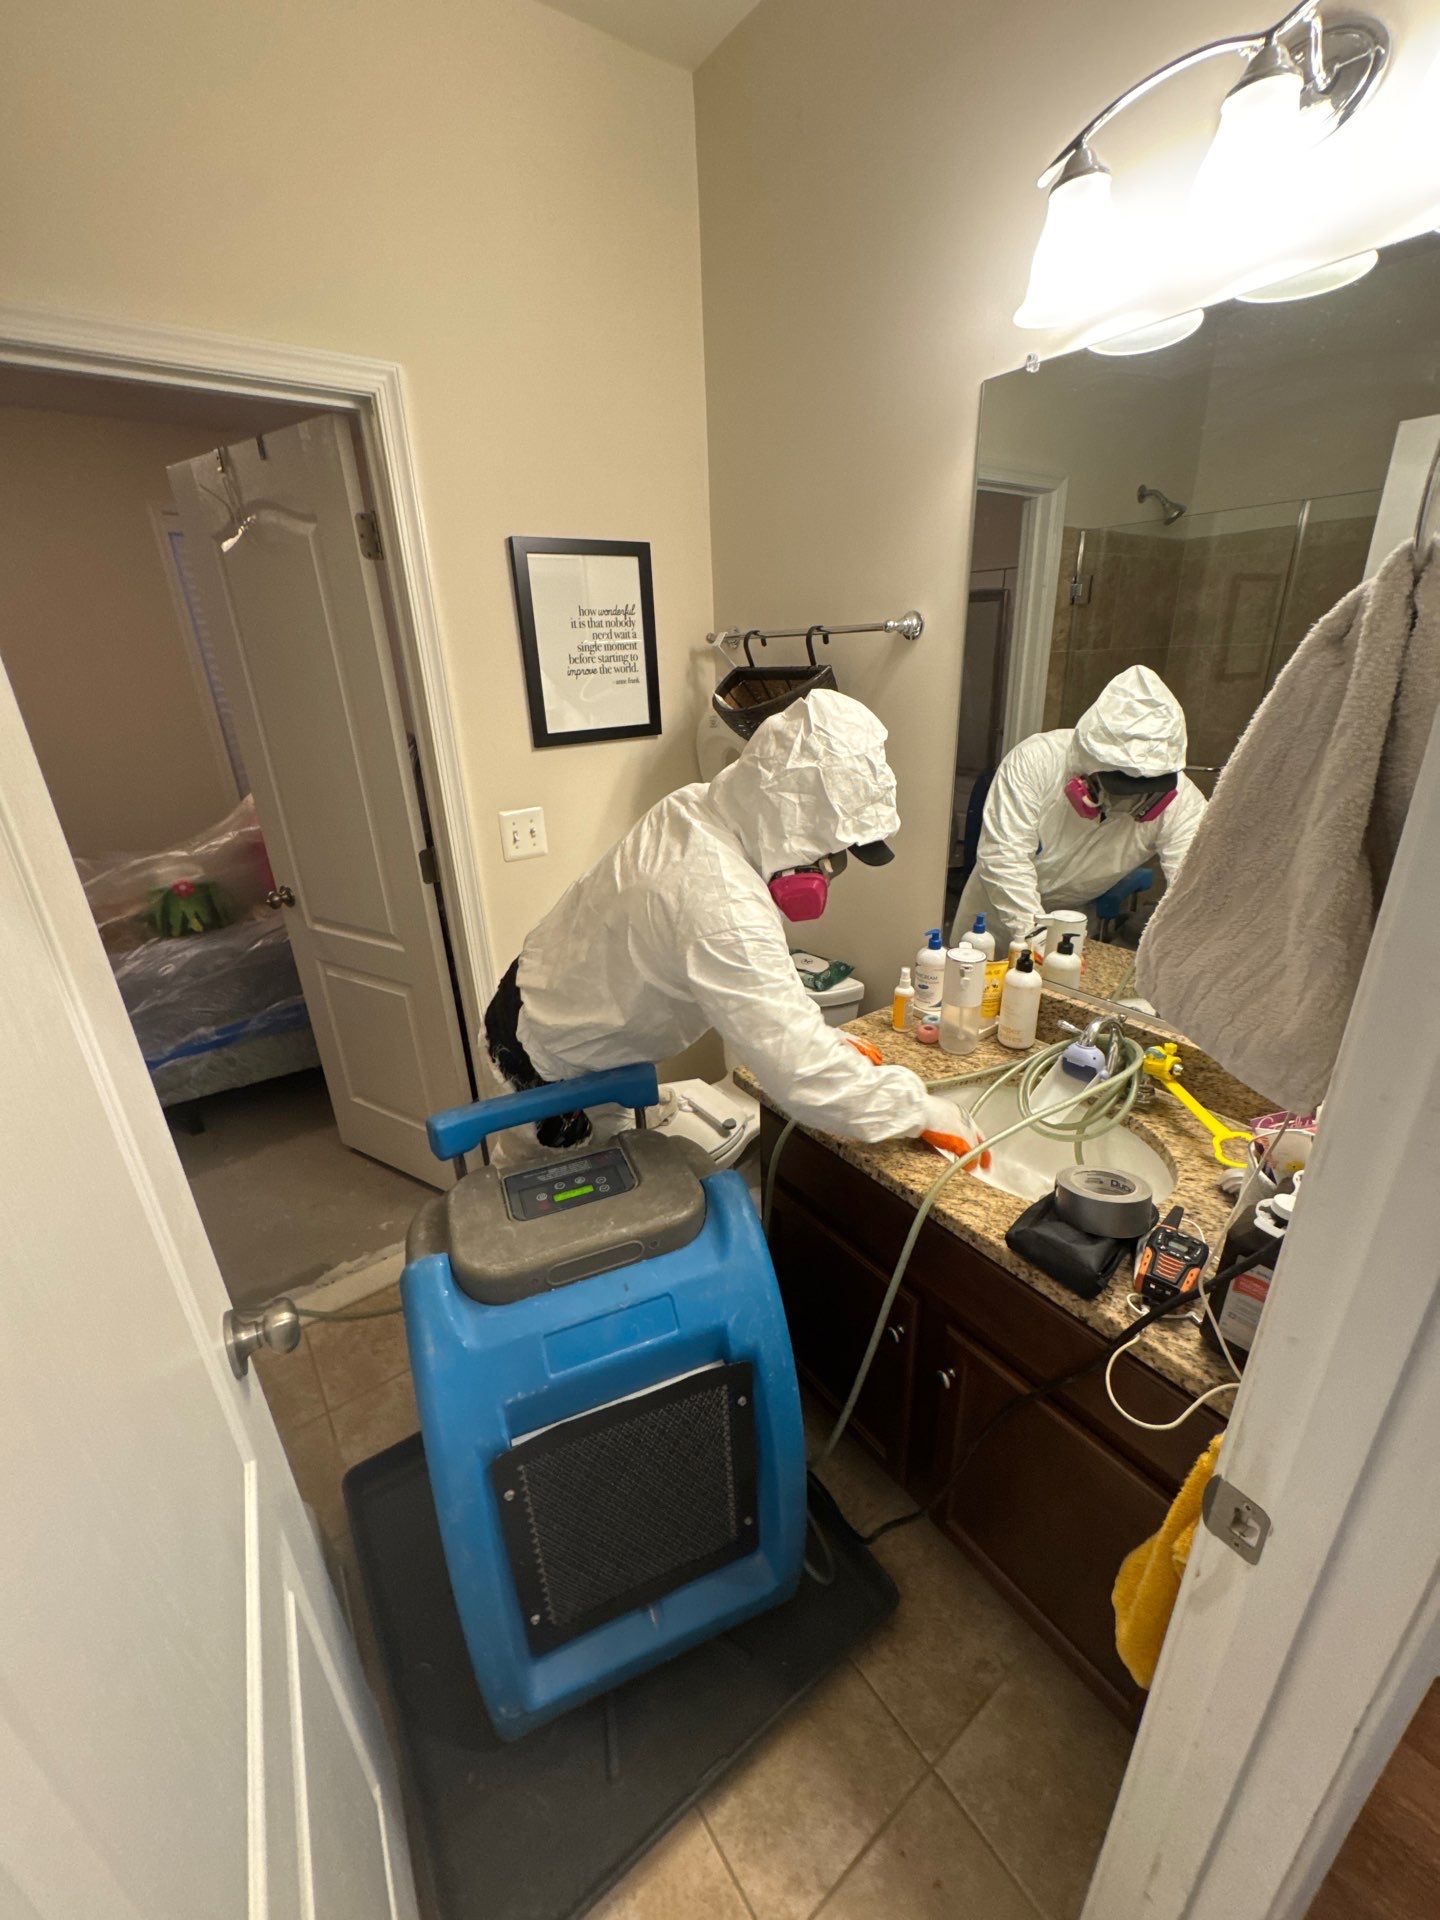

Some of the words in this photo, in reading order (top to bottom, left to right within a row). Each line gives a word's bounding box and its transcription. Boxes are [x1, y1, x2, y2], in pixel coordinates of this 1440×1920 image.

[578, 605, 597, 617] how
[597, 604, 636, 621] wonderful
[571, 617, 577, 629] it
[578, 617, 587, 629] is
[587, 616, 604, 629] that
[605, 616, 636, 631] nobody
[592, 628, 613, 640] need
[614, 629, 631, 640] wait
[631, 631, 637, 639] a
[577, 641, 603, 655] single
[603, 642, 638, 652] moment
[568, 653, 597, 665] before
[597, 652, 630, 666] starting
[629, 653, 639, 662] to
[567, 666, 598, 680] improve
[599, 664, 613, 675] the
[613, 662, 639, 674] world.
